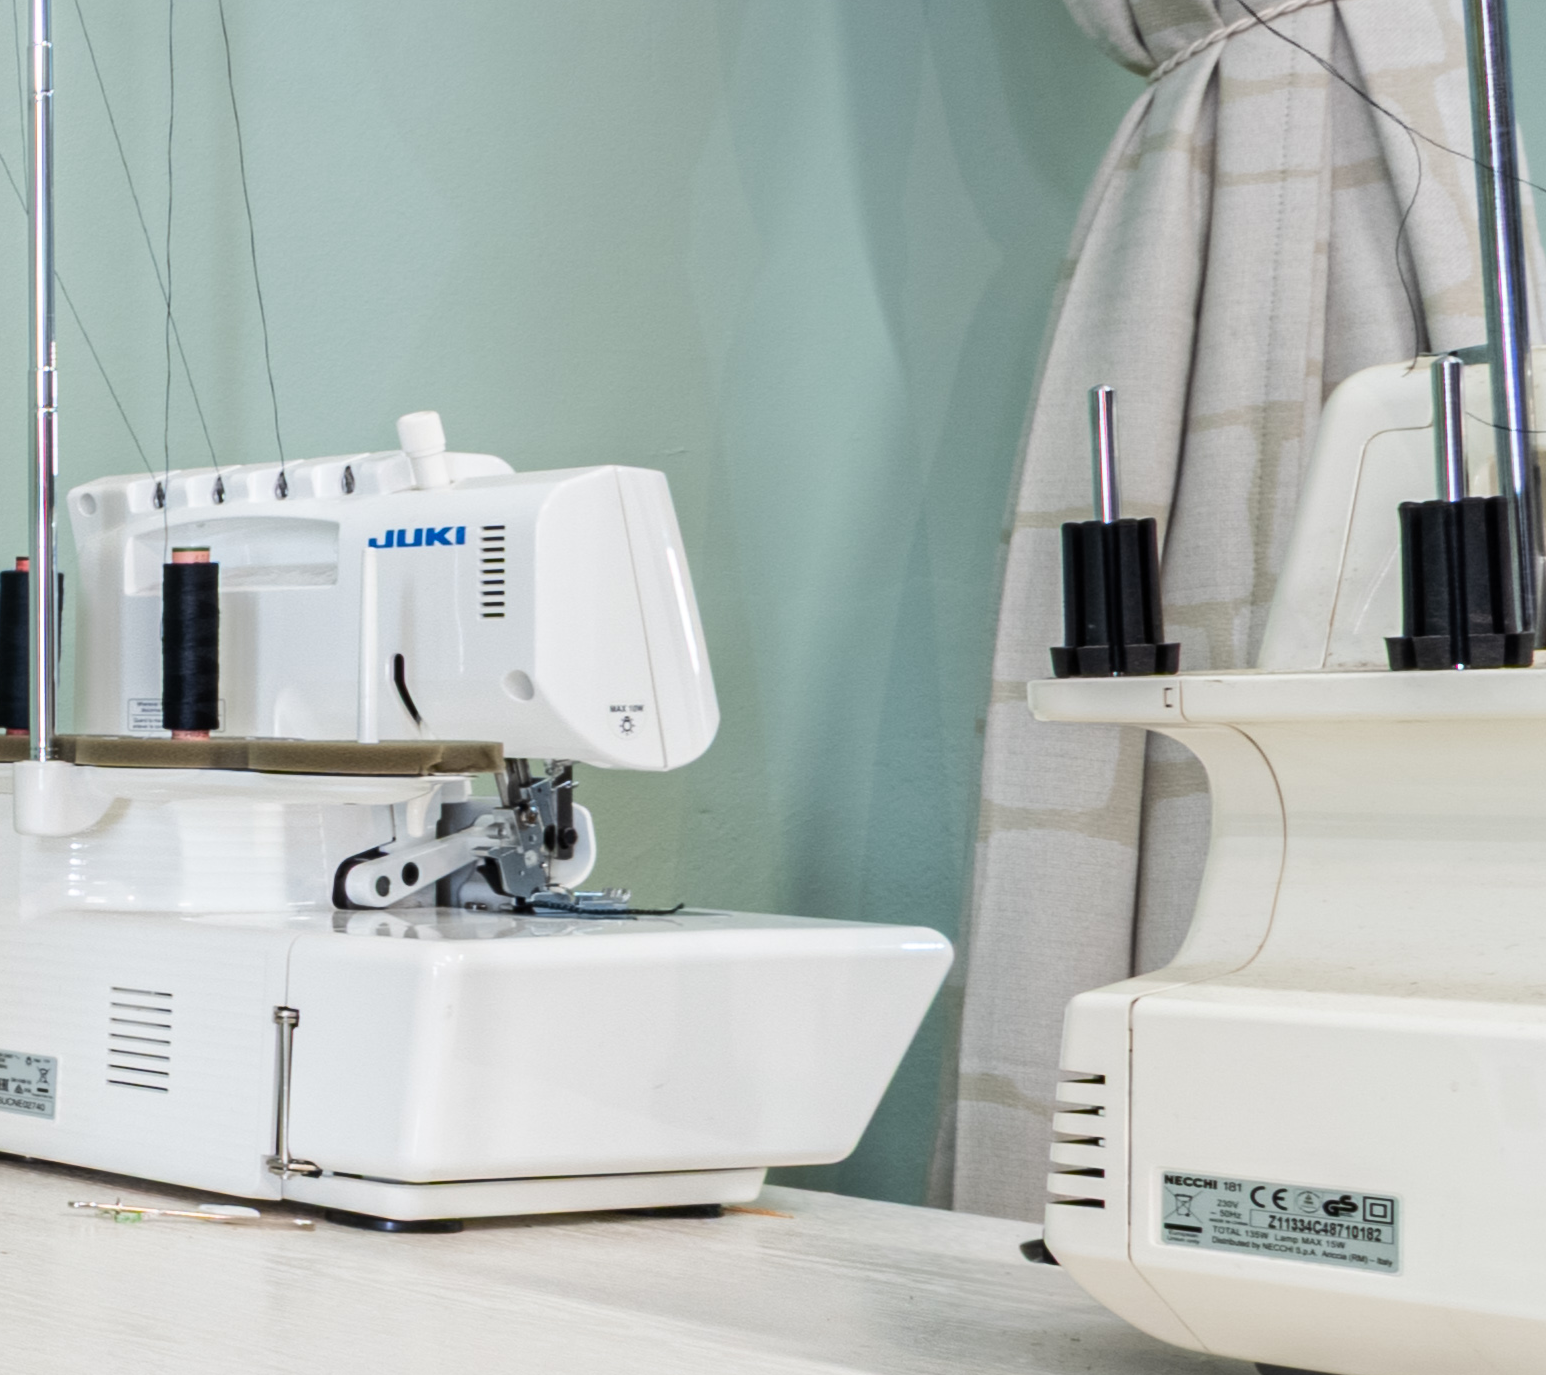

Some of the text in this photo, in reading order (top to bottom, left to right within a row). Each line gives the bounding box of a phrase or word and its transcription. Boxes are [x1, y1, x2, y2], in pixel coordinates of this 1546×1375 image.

[368, 526, 466, 549] JUKI
[1164, 1174, 1242, 1193] NECCHI 181
[1217, 1199, 1239, 1209] 230V
[1250, 1185, 1288, 1211] CE
[1219, 1209, 1242, 1219] 50Hz
[1212, 1236, 1250, 1249] Distributed
[1251, 1241, 1260, 1251] by
[1262, 1243, 1293, 1253] NECCHI
[1213, 1225, 1241, 1237] TOTAL
[1275, 1234, 1298, 1245] Lamp
[1301, 1237, 1322, 1247] MAX
